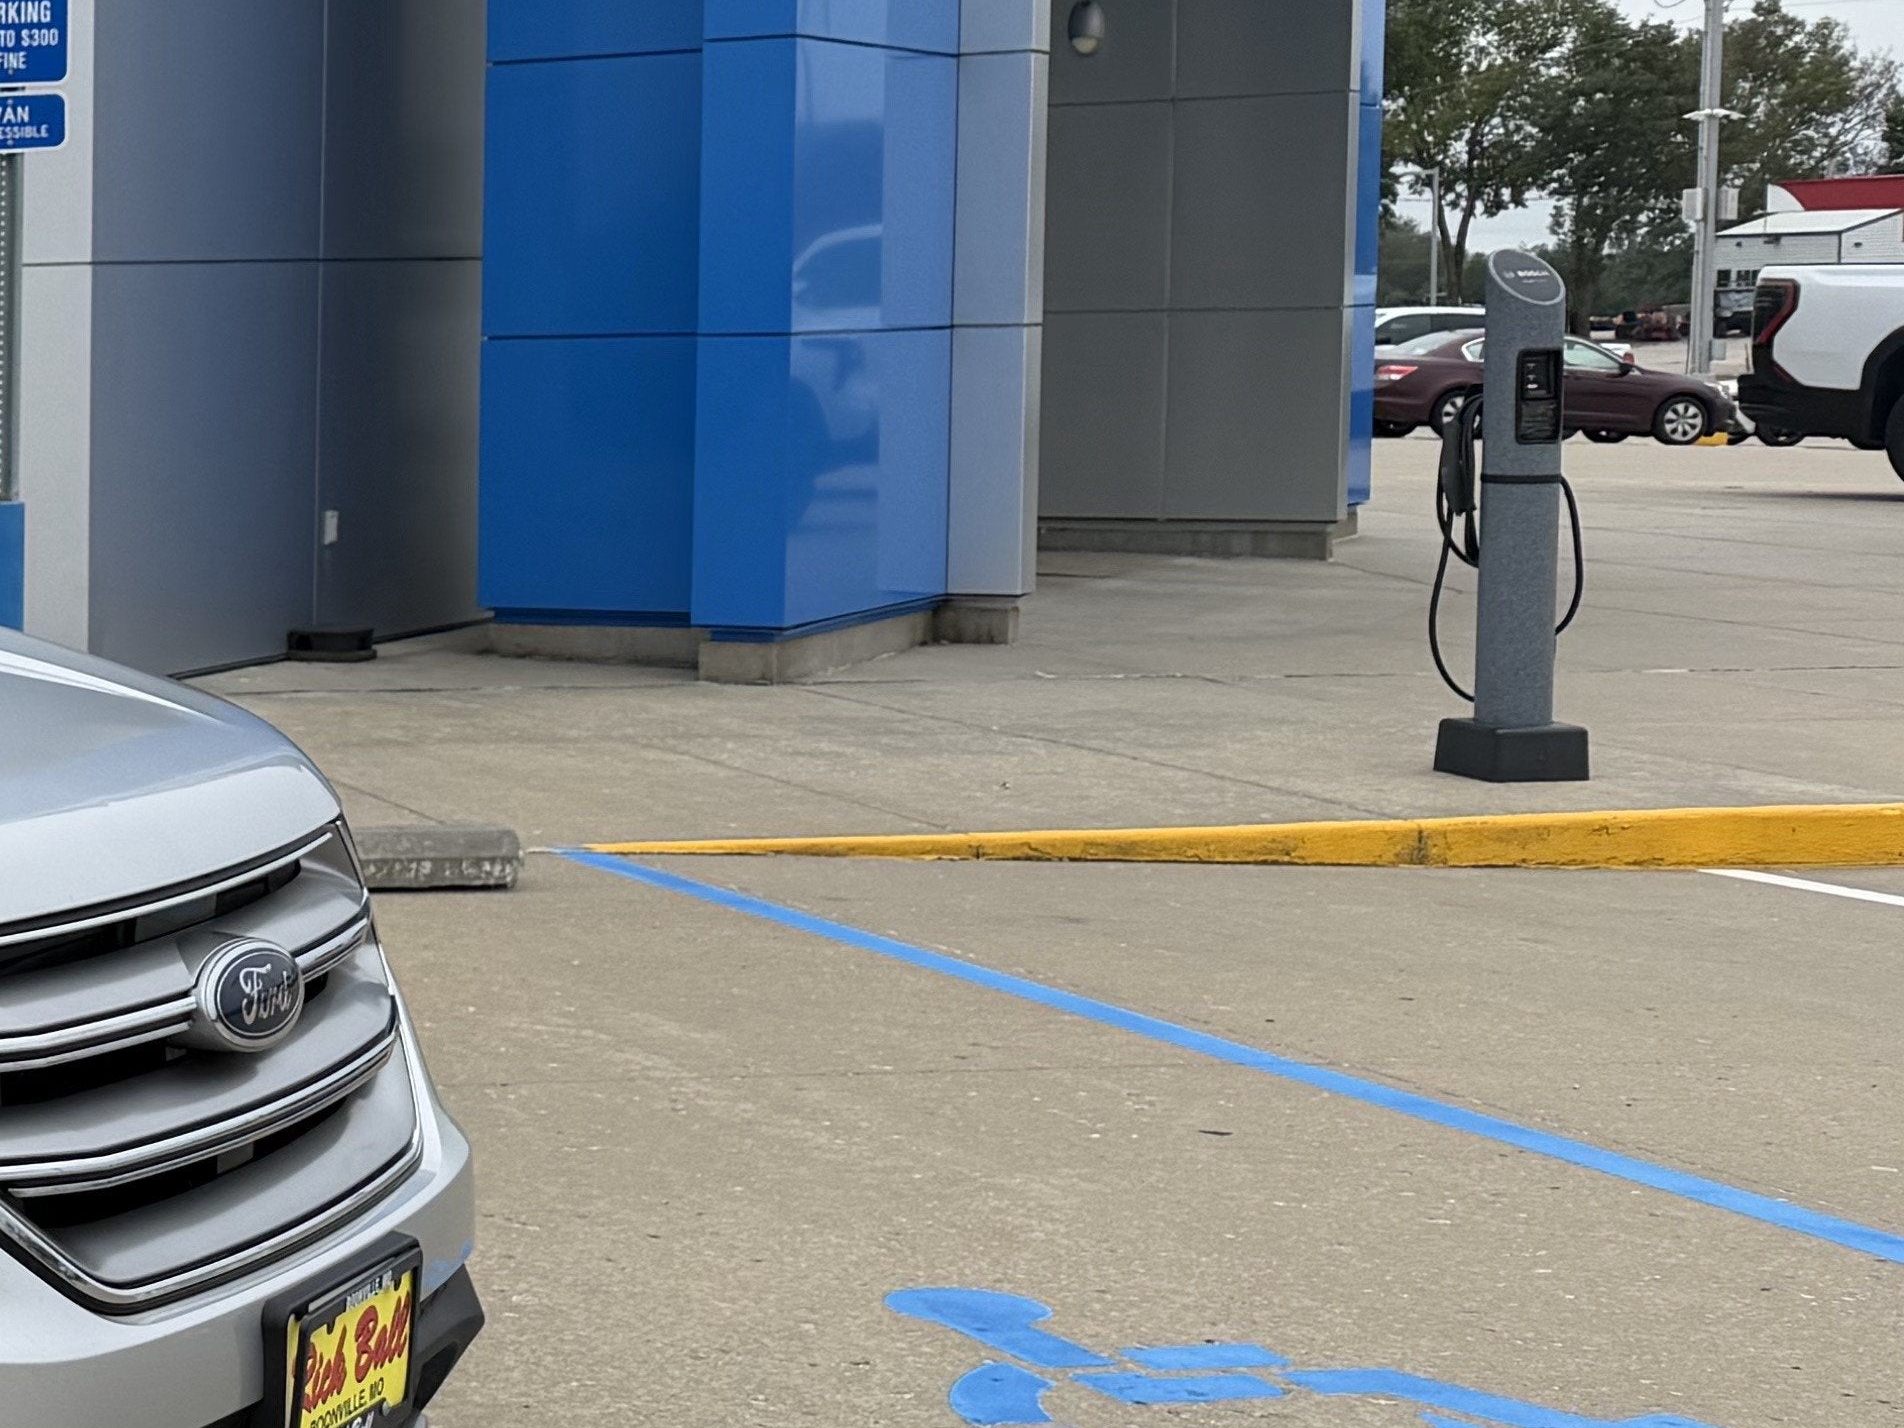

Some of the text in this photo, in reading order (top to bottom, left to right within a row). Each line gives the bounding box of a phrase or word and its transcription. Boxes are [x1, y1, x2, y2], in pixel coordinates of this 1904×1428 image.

[21, 28, 59, 46] $300
[239, 963, 292, 1025] Ford
[355, 1291, 410, 1383] Ball
[369, 1377, 384, 1401] MO
